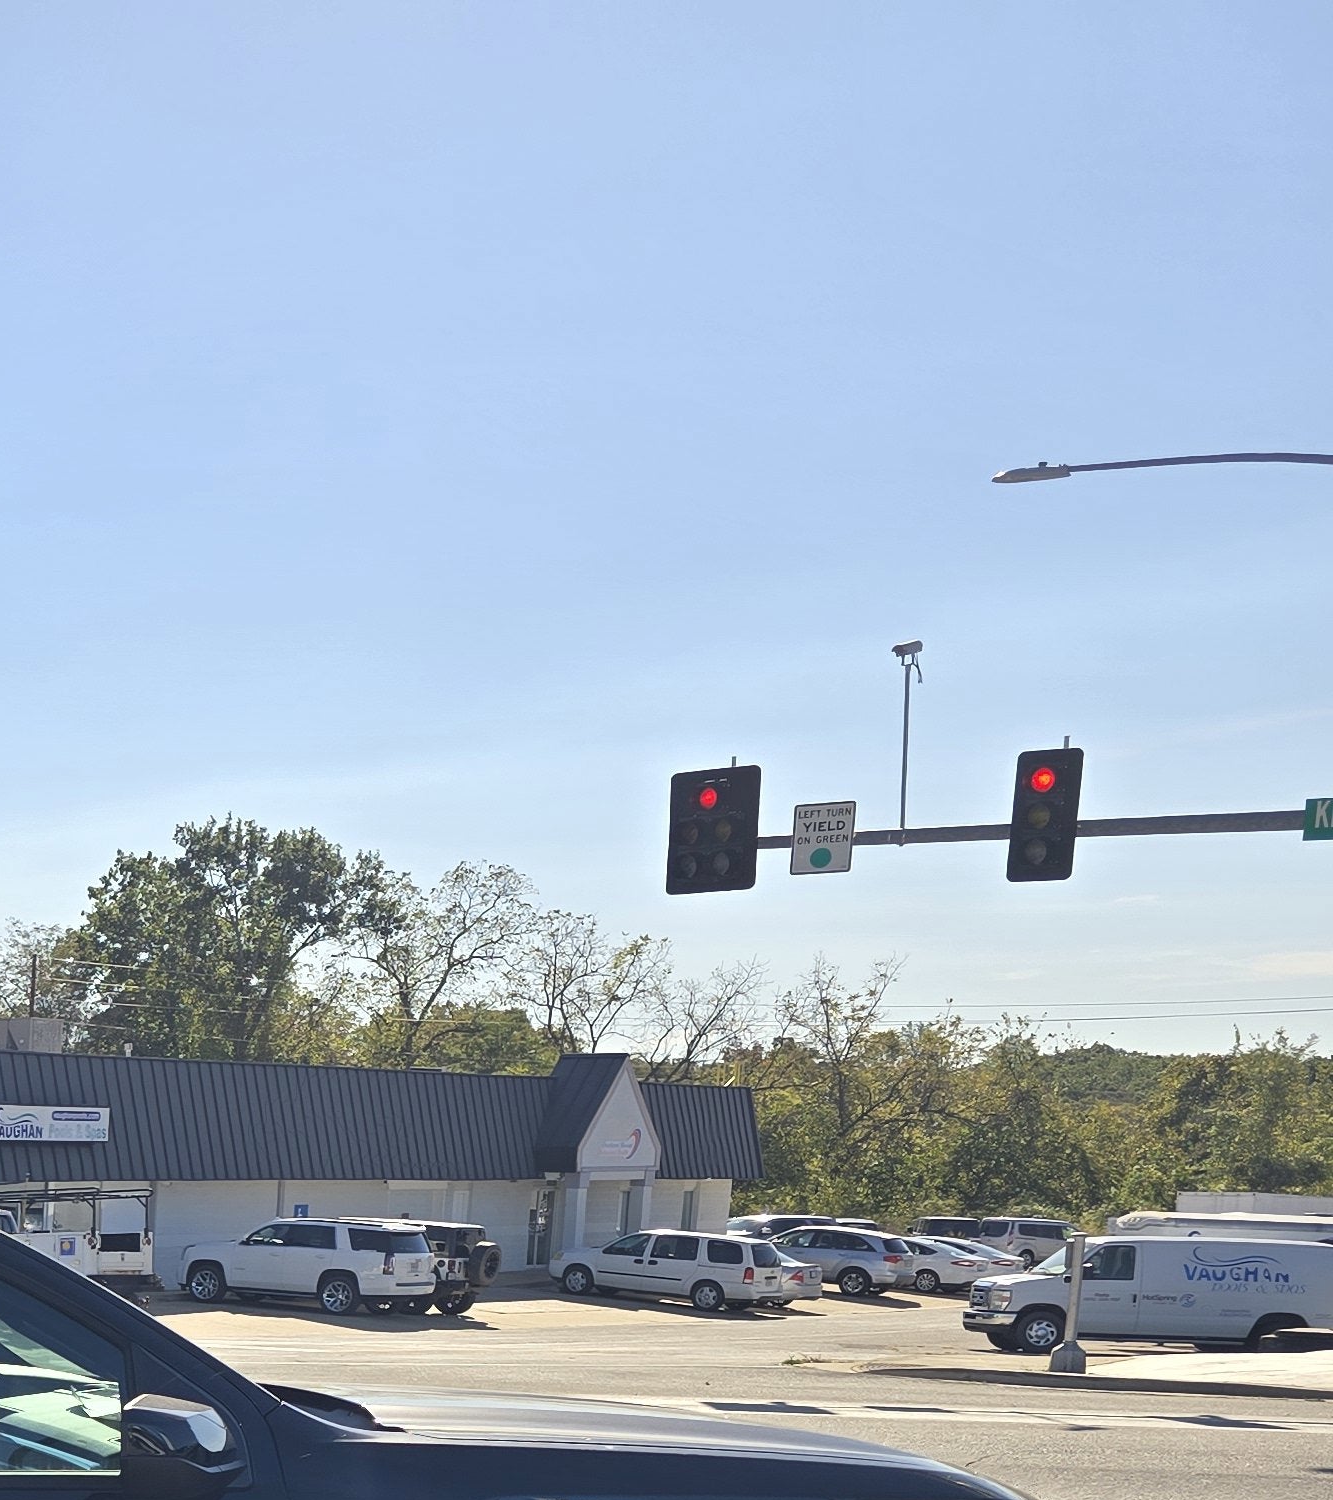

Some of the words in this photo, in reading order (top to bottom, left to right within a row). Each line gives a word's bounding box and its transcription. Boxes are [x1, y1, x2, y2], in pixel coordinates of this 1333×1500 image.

[798, 810, 821, 819] LEFT
[827, 808, 852, 817] TURN
[1315, 801, 1333, 828] K
[803, 820, 846, 832] YIELD
[797, 837, 811, 845] ON
[816, 834, 849, 843] GREEN
[85, 1124, 107, 1140] Spas
[1183, 1264, 1290, 1283] VAUGHAN
